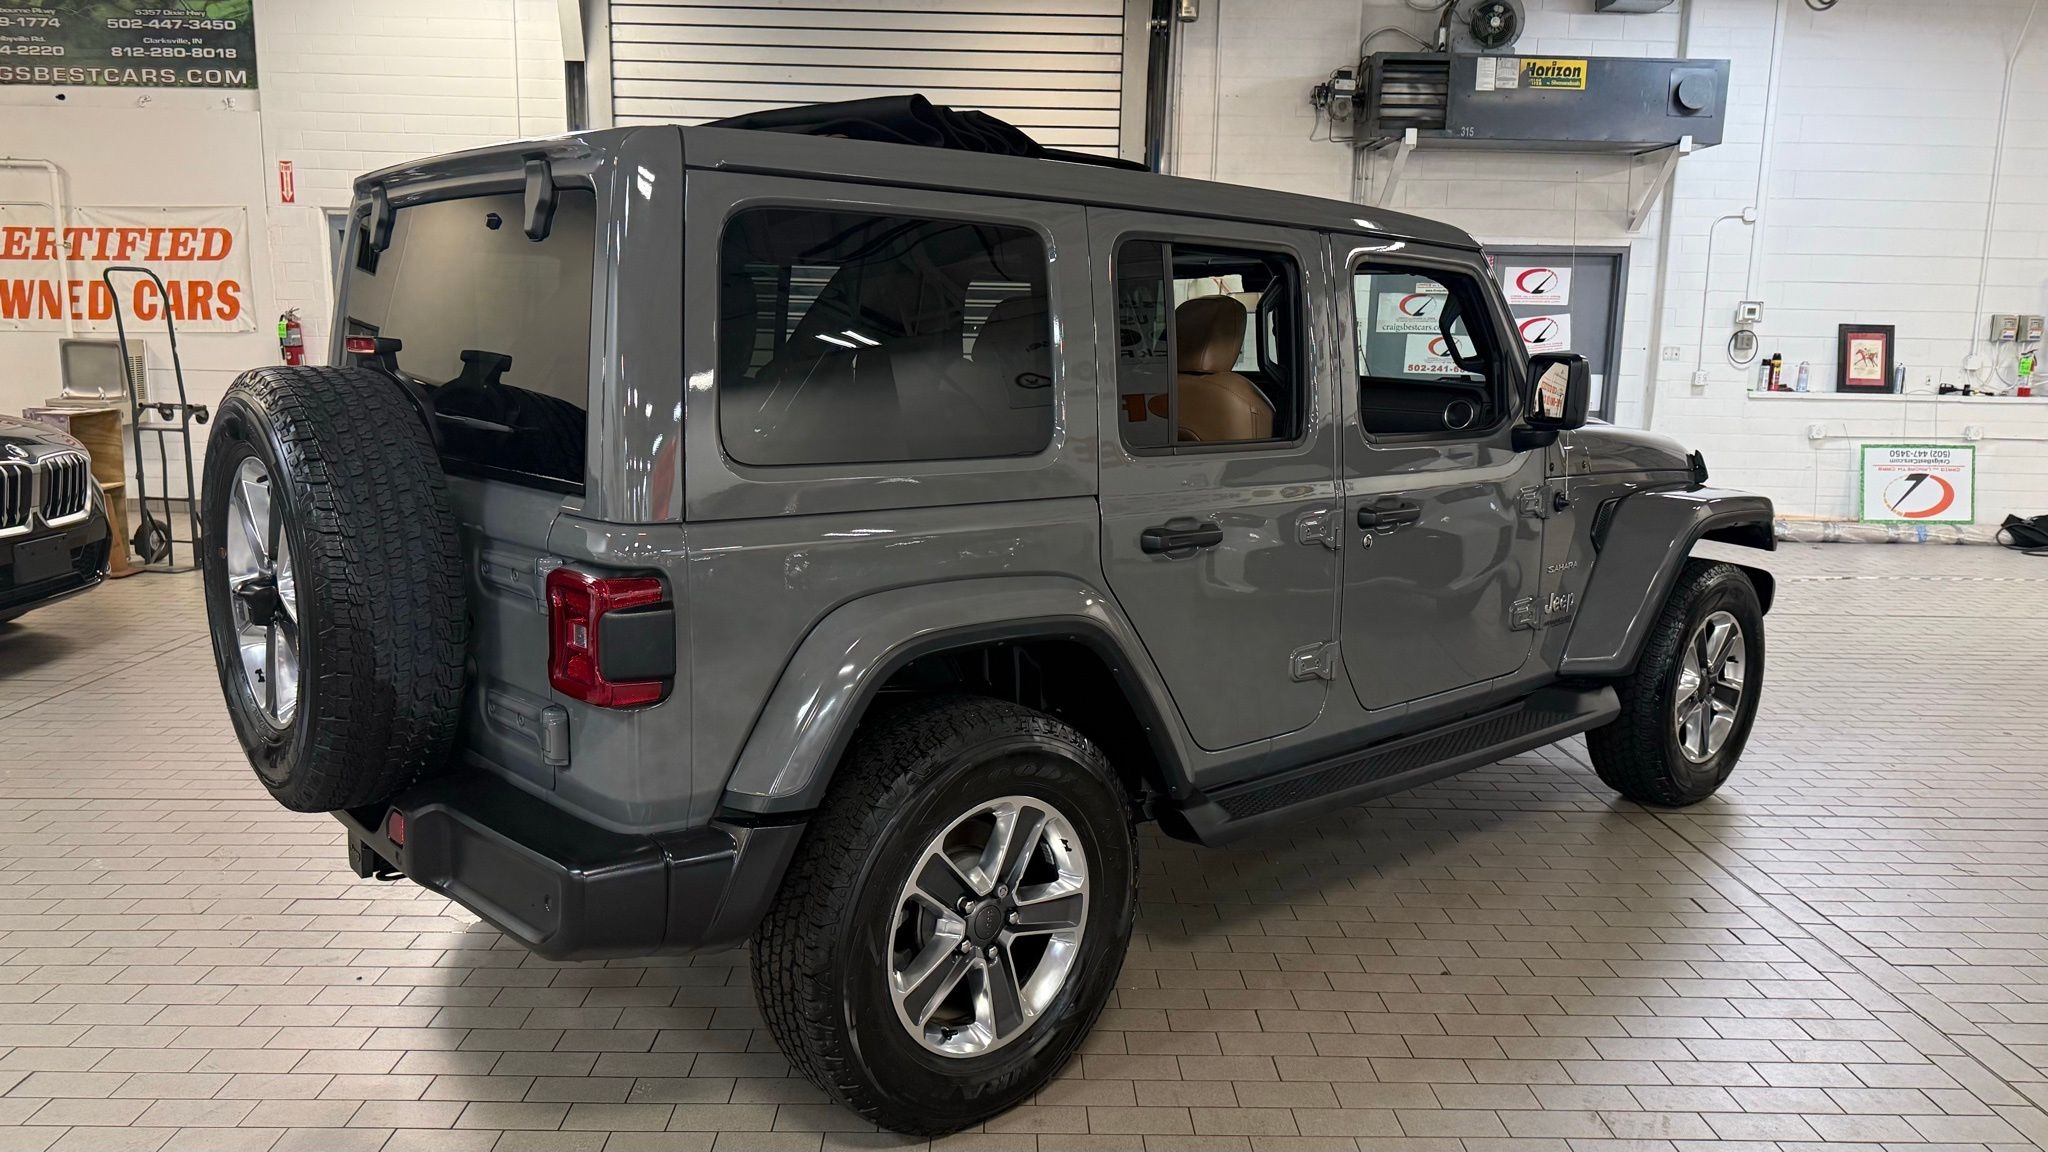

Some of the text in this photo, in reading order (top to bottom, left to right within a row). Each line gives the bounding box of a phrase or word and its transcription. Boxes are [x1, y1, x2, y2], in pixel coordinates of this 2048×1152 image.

[107, 18, 237, 31] 502-447-3450
[143, 37, 191, 45] Clarksville,
[0, 45, 65, 56] 4-2220
[111, 46, 237, 59] 812-280-8018
[0, 66, 248, 85] GSBESTCARS.COM
[1527, 61, 1581, 77] Horizon
[1460, 126, 1474, 137] 315
[0, 226, 234, 262] ERTIFIED
[0, 279, 242, 322] WNED CARS
[1930, 450, 1950, 458] (502)
[1547, 561, 1577, 573] SAHARA
[1544, 592, 1574, 614] Jeep
